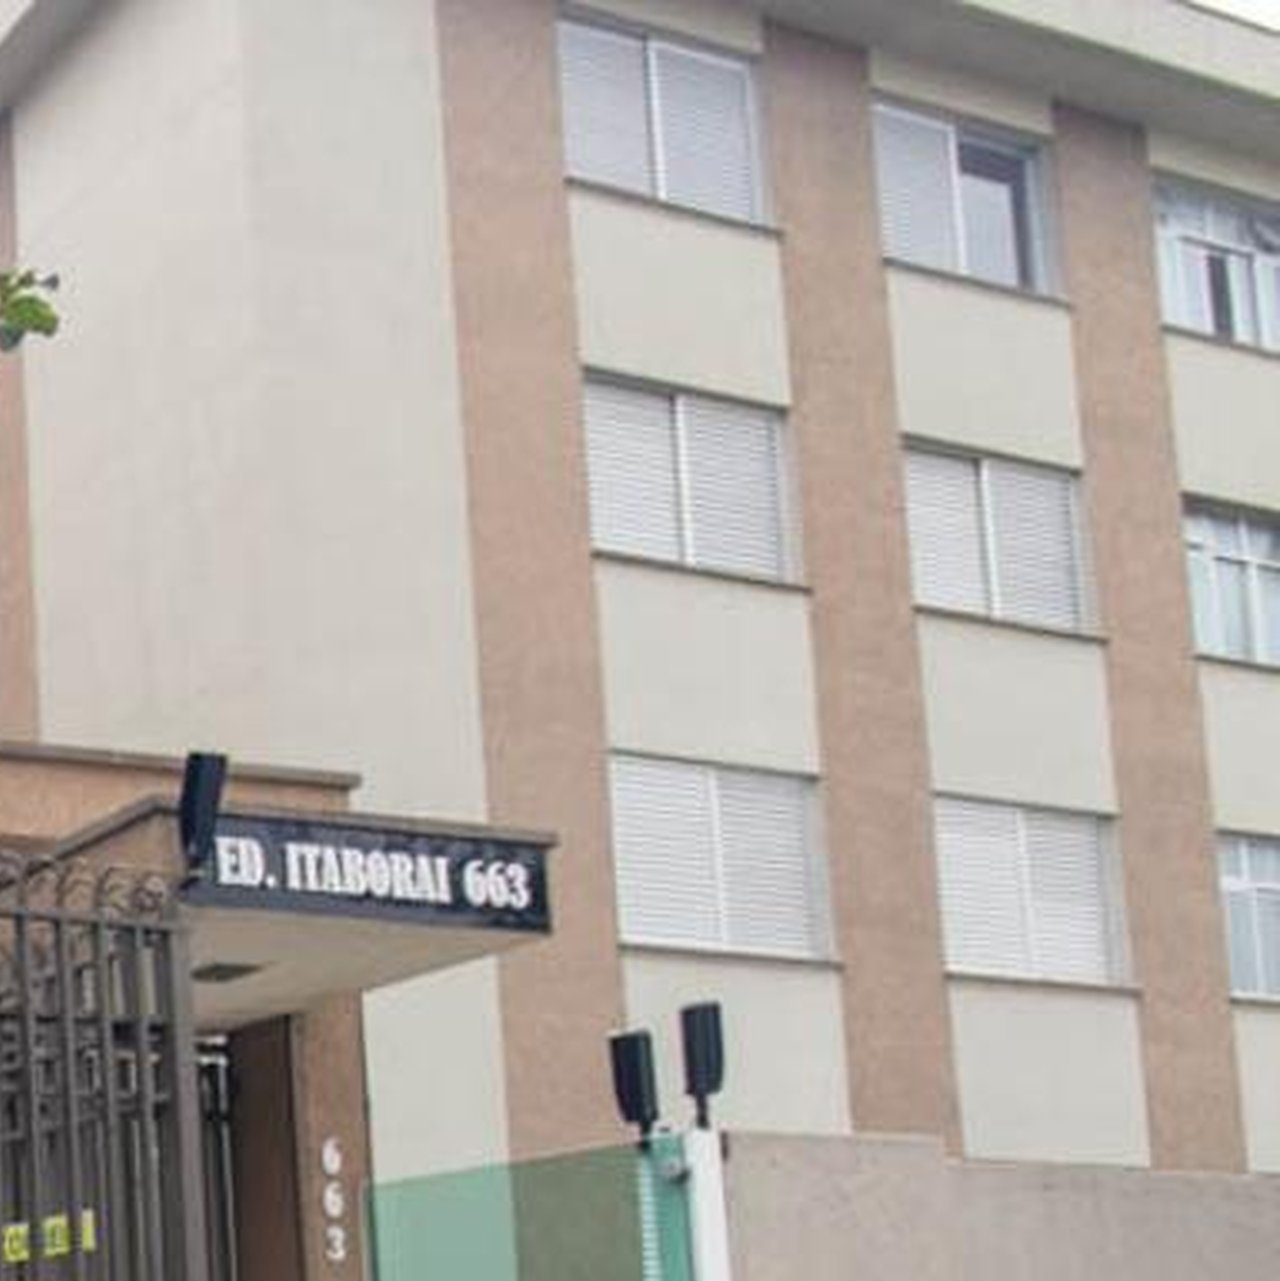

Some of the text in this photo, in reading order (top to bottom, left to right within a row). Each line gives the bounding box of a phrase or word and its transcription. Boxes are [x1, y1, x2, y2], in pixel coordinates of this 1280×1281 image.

[215, 838, 276, 887] ED.
[463, 860, 531, 909] 663
[321, 1136, 346, 1261] 663
